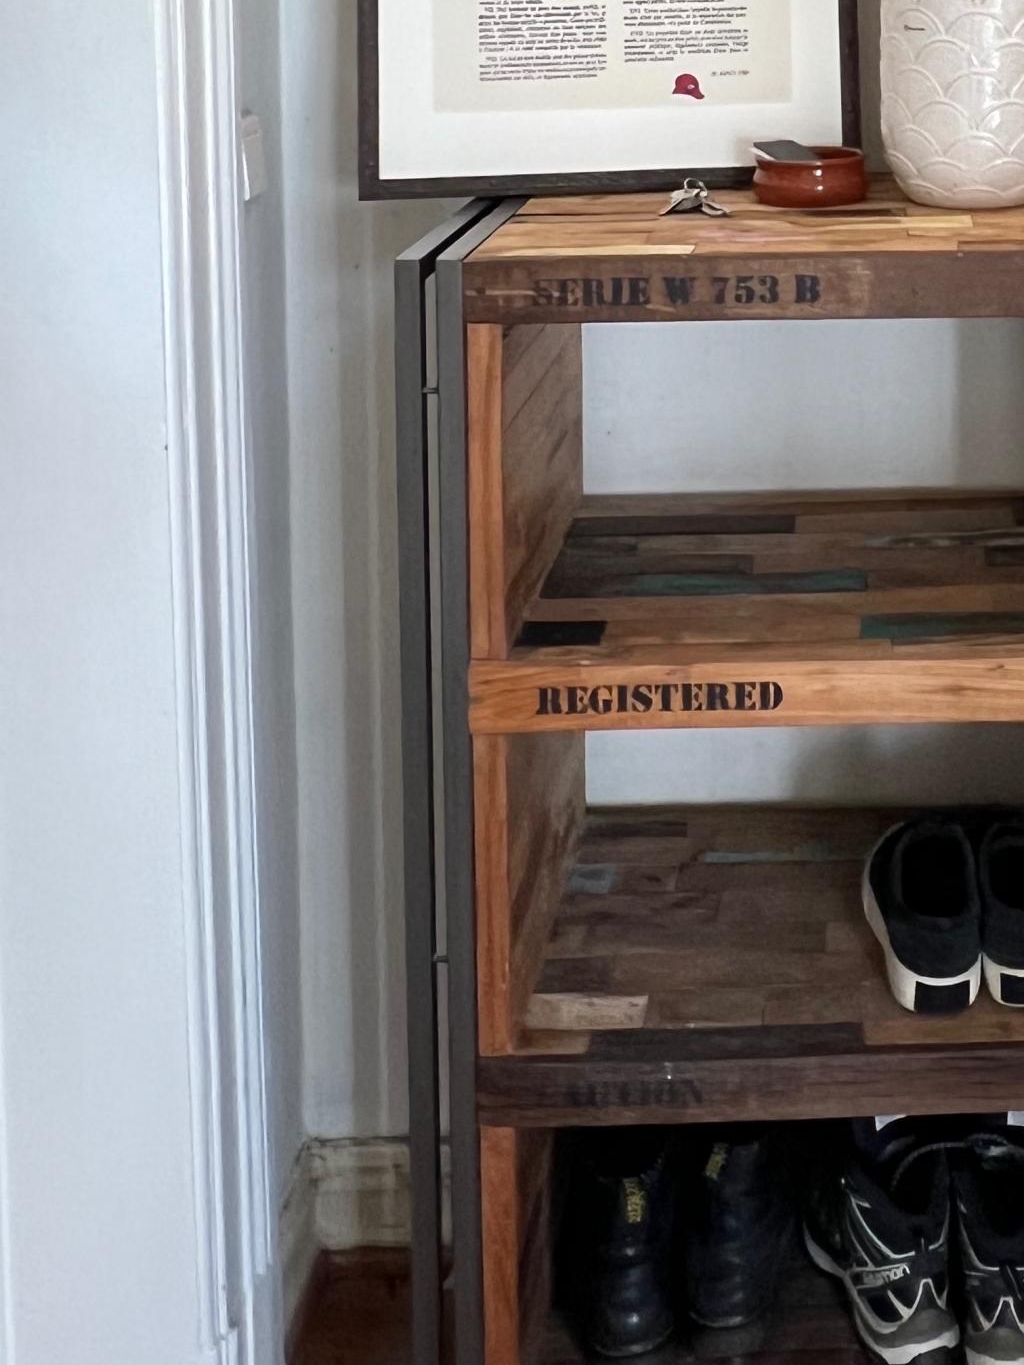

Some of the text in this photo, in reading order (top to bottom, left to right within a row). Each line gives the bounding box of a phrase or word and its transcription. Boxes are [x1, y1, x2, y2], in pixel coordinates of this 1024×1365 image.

[532, 273, 821, 306] SERIE W 753 B
[536, 681, 784, 715] REGISTERED
